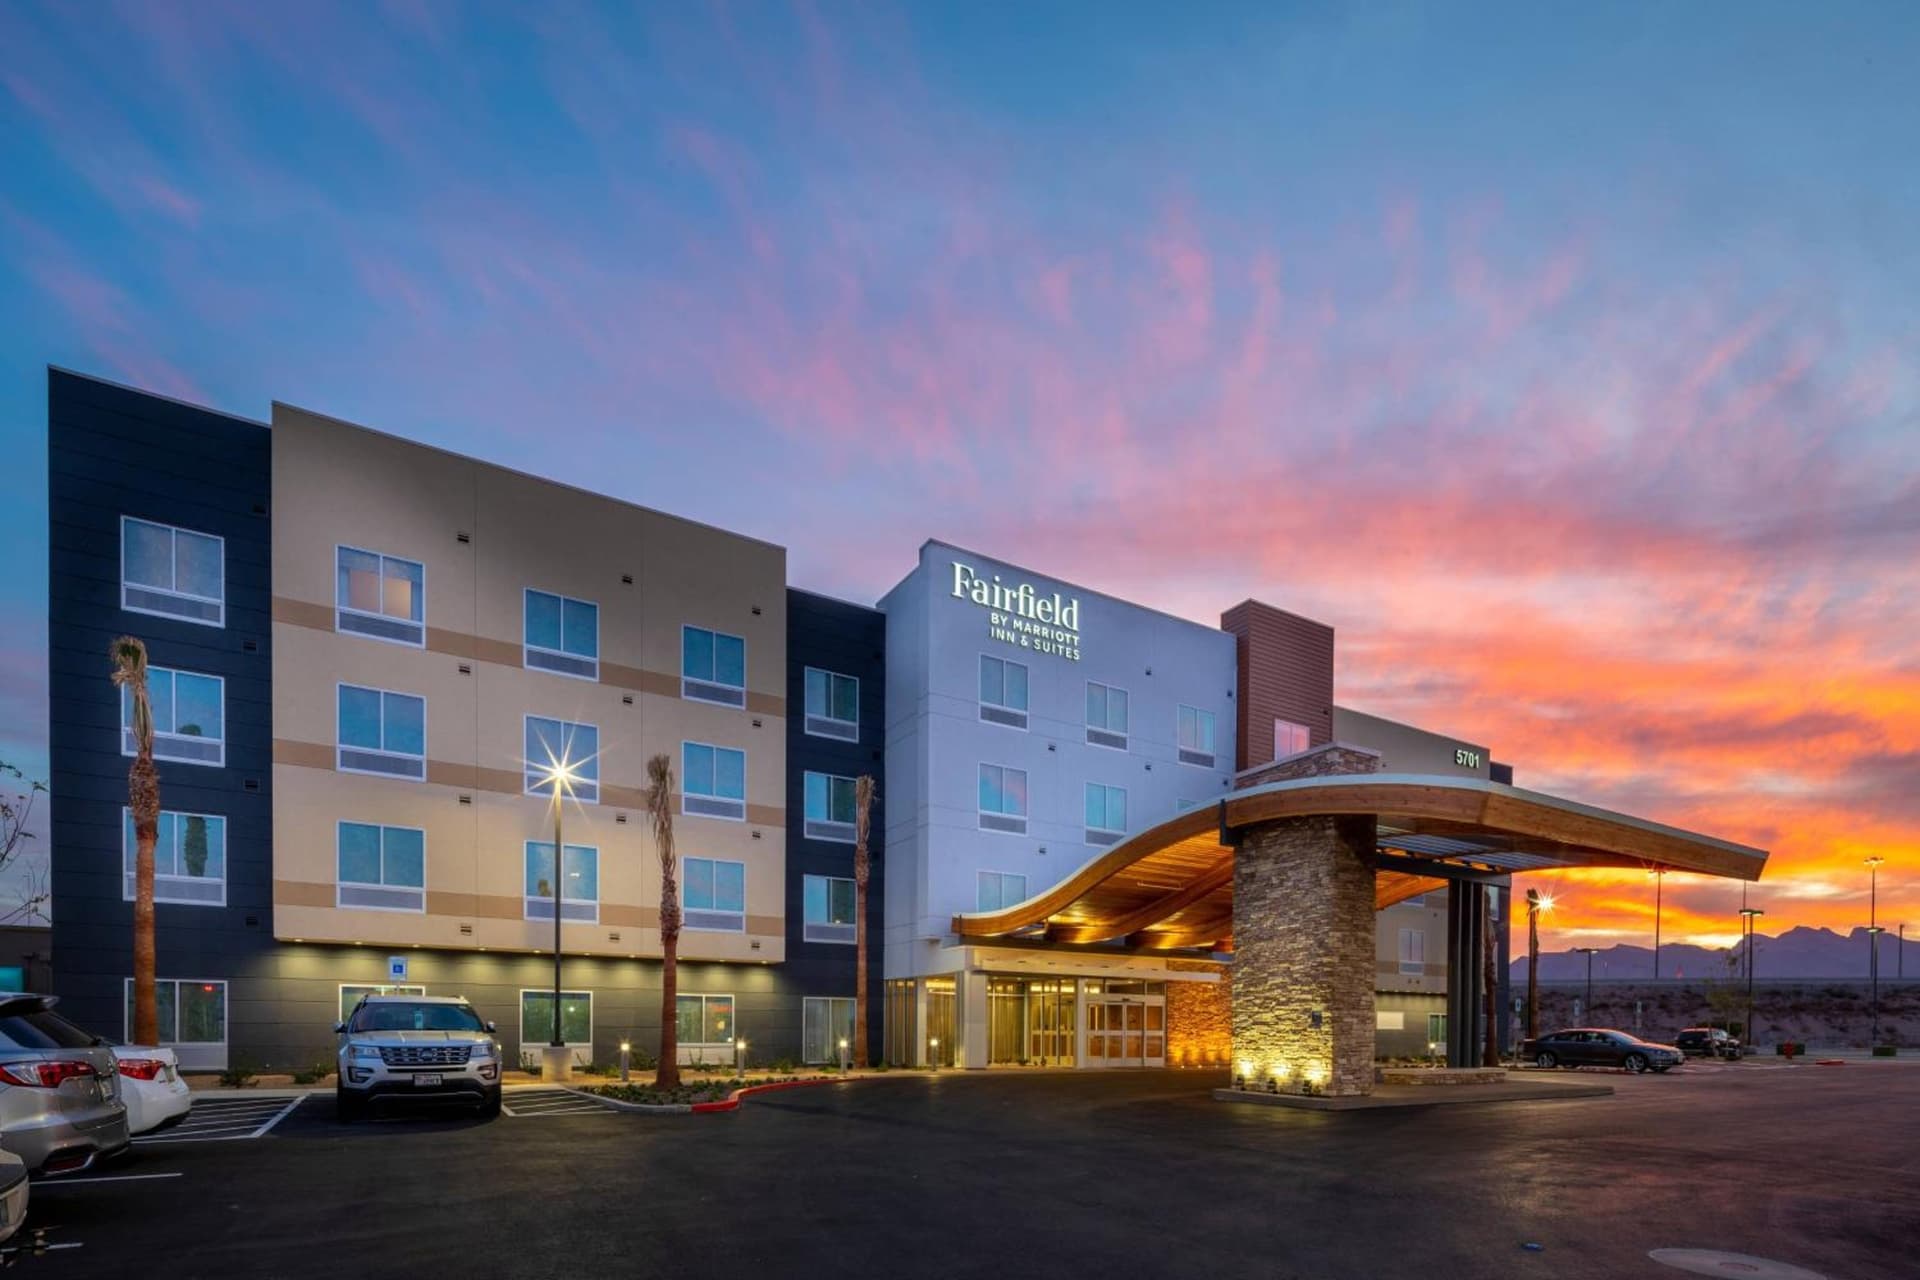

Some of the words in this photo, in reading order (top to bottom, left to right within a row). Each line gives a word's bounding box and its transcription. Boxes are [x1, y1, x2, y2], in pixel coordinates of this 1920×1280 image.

[951, 561, 1080, 631] Fairfield
[990, 626, 1015, 643] INN
[1020, 635, 1028, 646] &
[1033, 638, 1080, 660] SUITES
[991, 612, 1008, 627] BY
[1013, 618, 1080, 646] MARRIOTT
[1456, 749, 1479, 768] 5701
